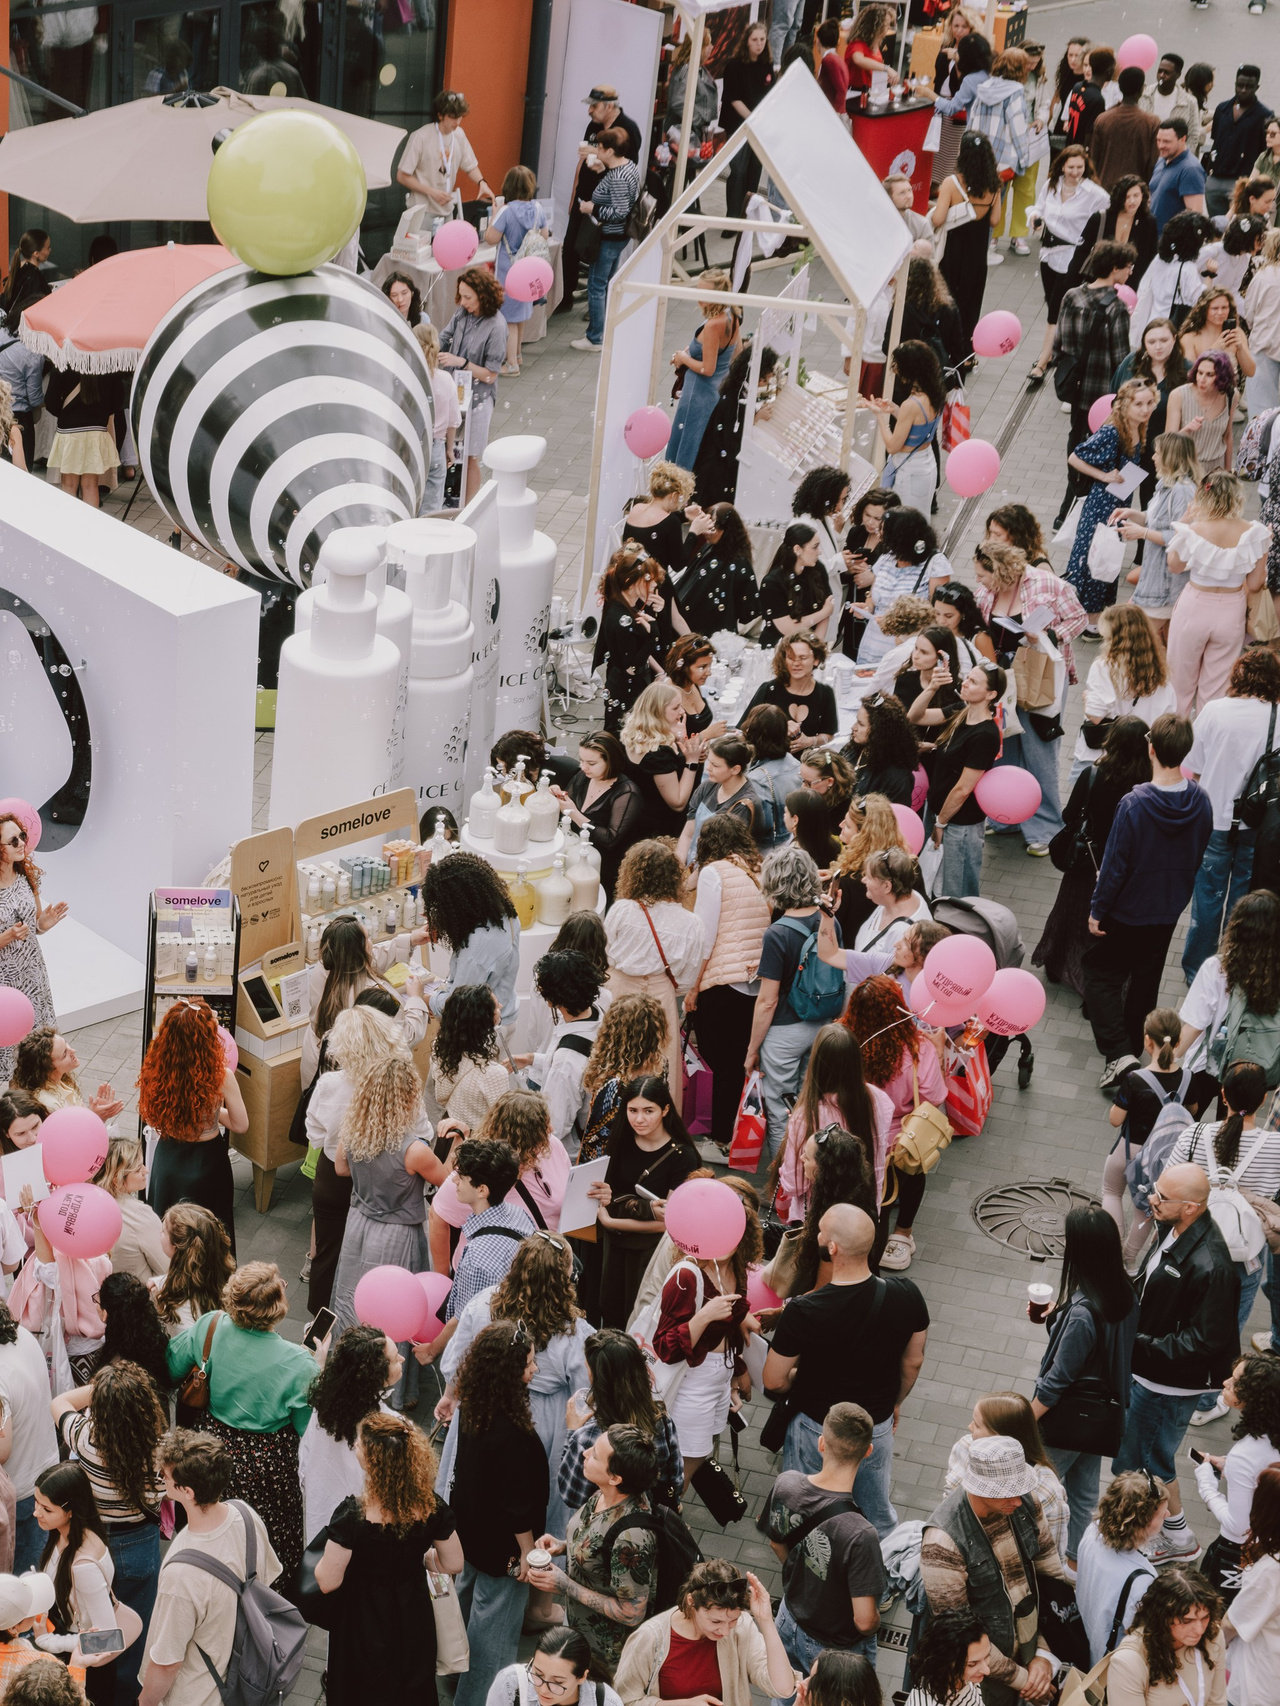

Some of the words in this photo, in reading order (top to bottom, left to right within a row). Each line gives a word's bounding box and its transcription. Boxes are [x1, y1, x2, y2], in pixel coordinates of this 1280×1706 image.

[500, 671, 529, 687] ICE
[419, 783, 449, 799] ICE
[320, 808, 392, 840] somelove
[240, 884, 270, 898] натуральный
[270, 882, 283, 890] уход
[165, 896, 222, 905] somelove
[270, 950, 299, 965] somelove
[932, 980, 953, 997] МЕТОД
[935, 971, 973, 996] КУДРЯВЫЙ
[985, 1019, 1007, 1034] МЕТОД
[989, 1012, 1029, 1032] КУДРЯВЫЙ
[58, 1194, 74, 1217] МЕТОД
[64, 1195, 85, 1236] КУДРЯВЫЙ
